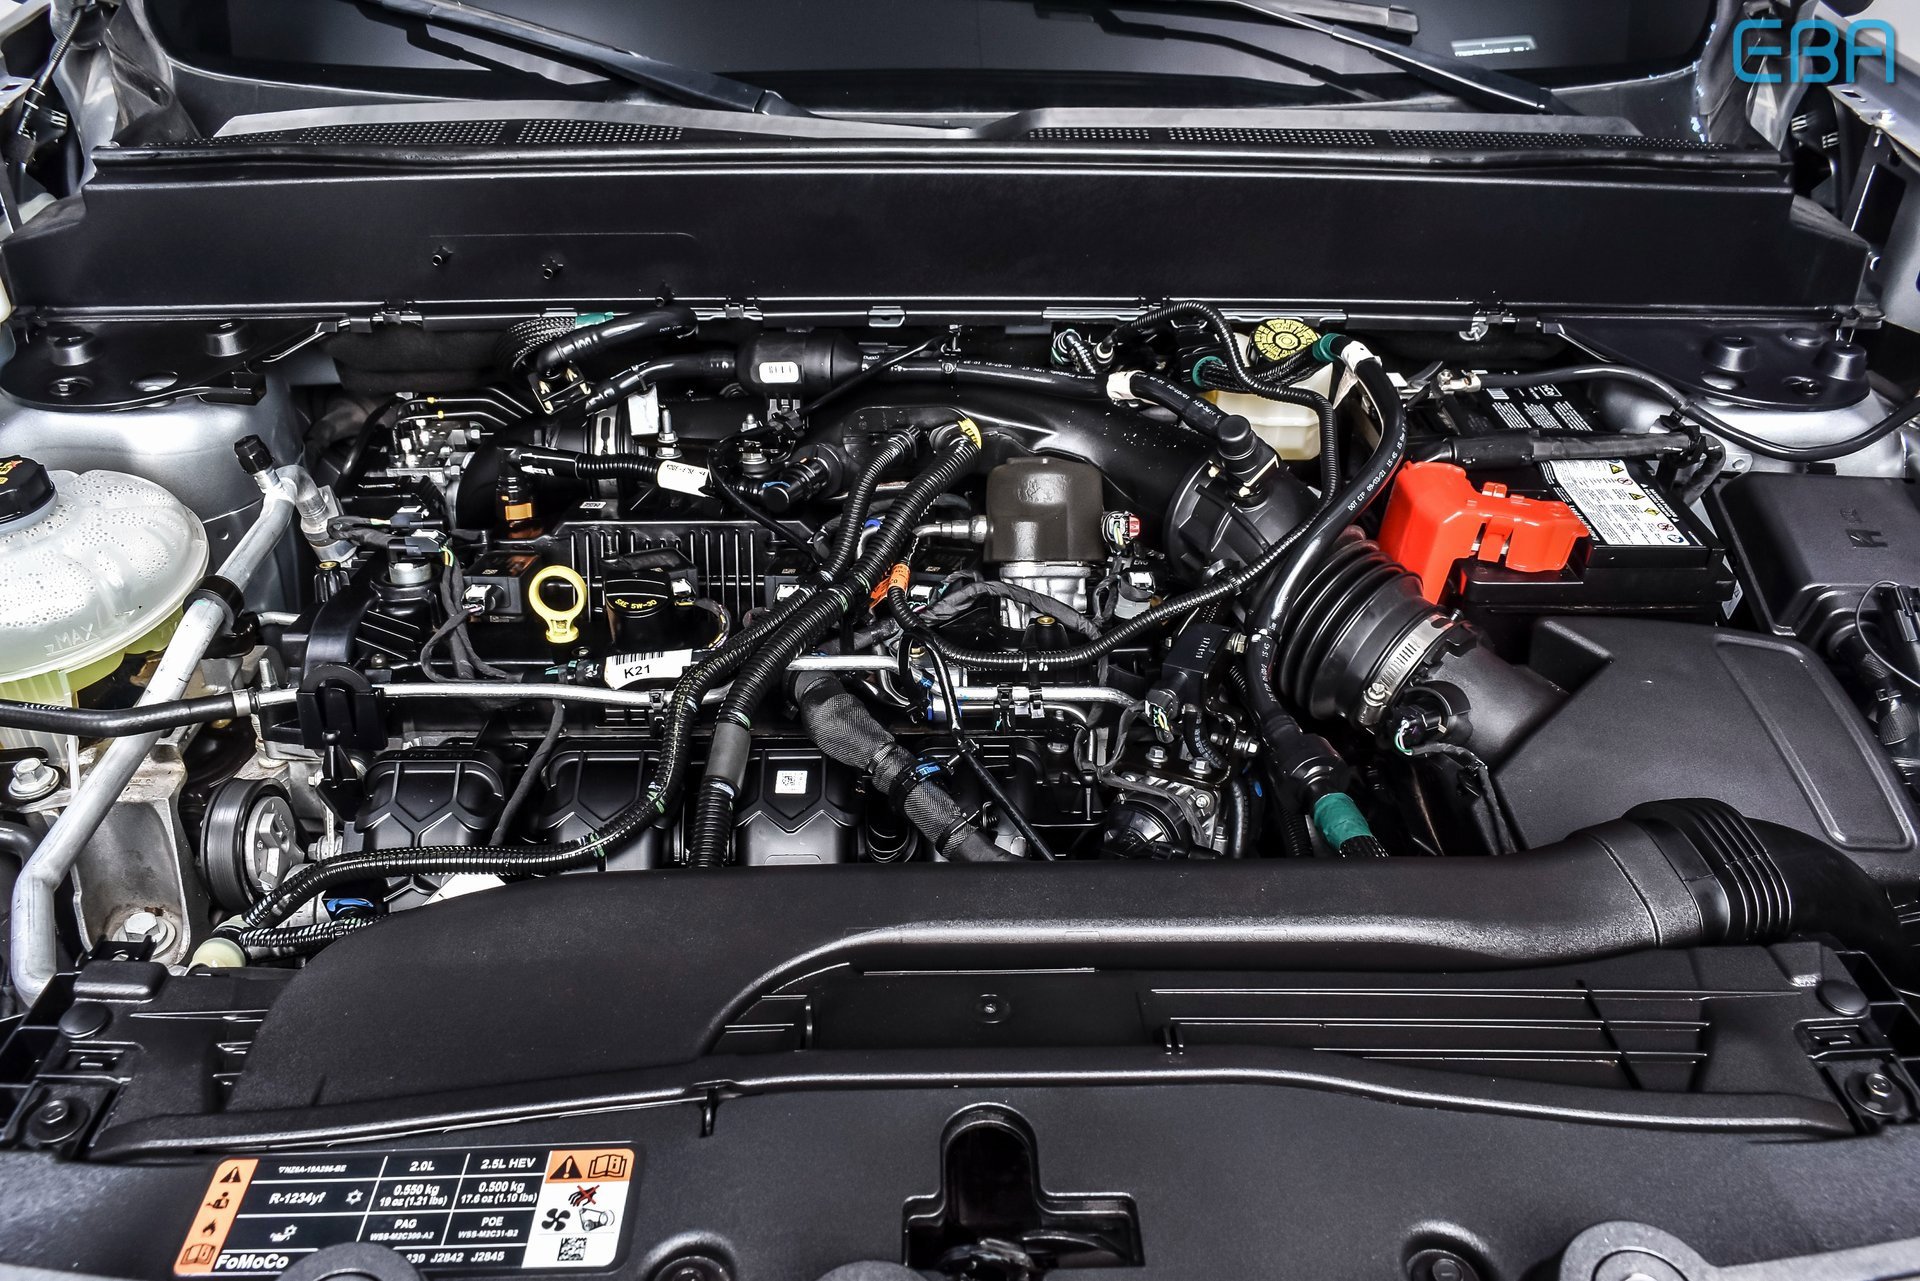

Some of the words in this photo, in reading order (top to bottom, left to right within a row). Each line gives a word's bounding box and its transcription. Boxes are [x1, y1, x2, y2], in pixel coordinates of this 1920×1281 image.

[615, 598, 630, 608] SAE
[630, 599, 658, 609] 5W-30
[54, 623, 98, 649] MAX
[624, 664, 650, 679] K21
[409, 1160, 435, 1172] 2.0L
[480, 1158, 507, 1169] 2.5L
[508, 1157, 537, 1169] HEV
[393, 1184, 424, 1196] 0.550
[425, 1183, 440, 1197] kg
[478, 1181, 509, 1193] 0.500
[510, 1181, 526, 1193] kg
[268, 1191, 327, 1206] R-1234yf
[379, 1197, 391, 1207] 19
[391, 1198, 405, 1207] oz
[427, 1195, 448, 1207] lbs)
[461, 1194, 479, 1204] 17.6
[480, 1195, 494, 1204] oz
[518, 1192, 538, 1204] lbs)
[394, 1218, 418, 1229] PAG
[481, 1216, 504, 1227] POE
[215, 1254, 289, 1270] FoMoCo
[430, 1252, 464, 1263] J2842
[470, 1251, 505, 1263] J2845
